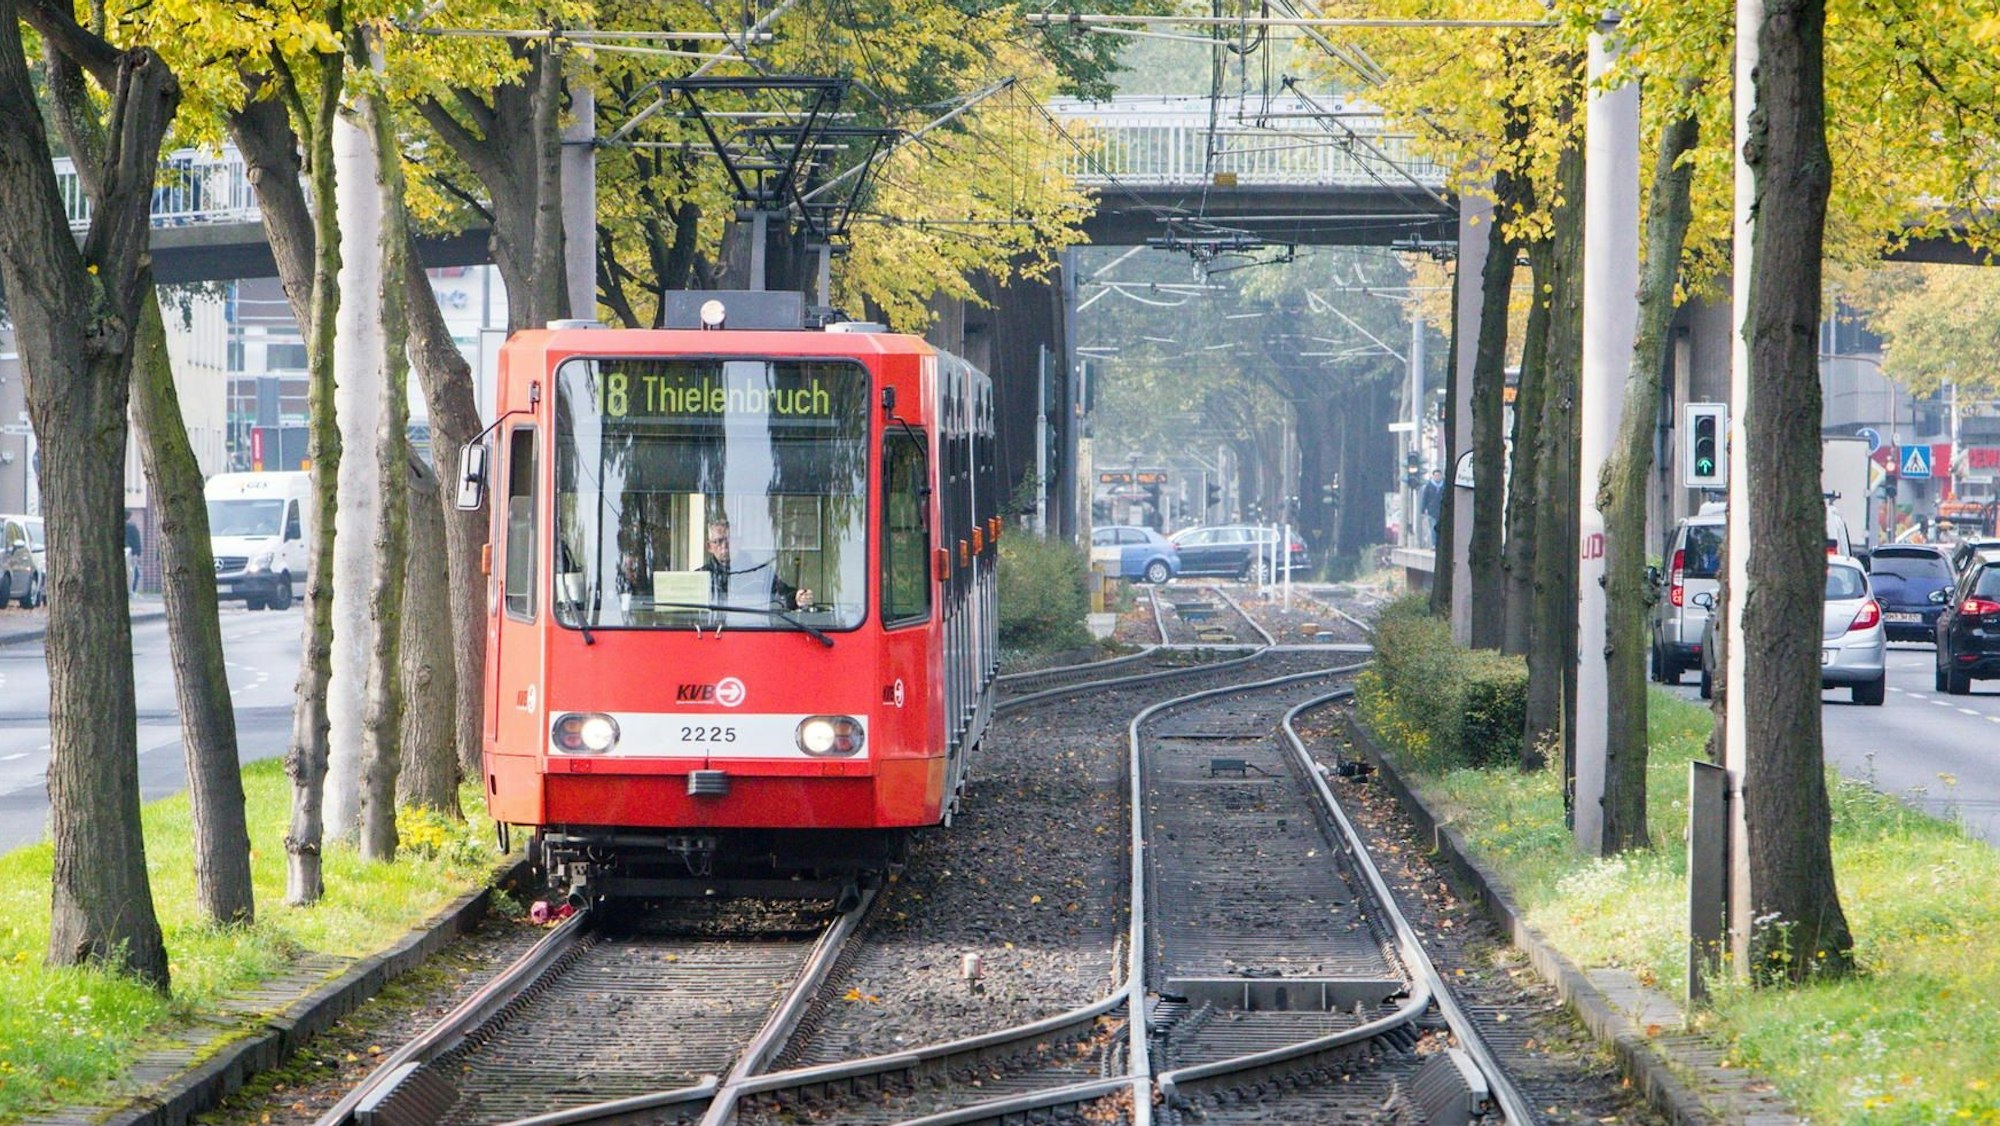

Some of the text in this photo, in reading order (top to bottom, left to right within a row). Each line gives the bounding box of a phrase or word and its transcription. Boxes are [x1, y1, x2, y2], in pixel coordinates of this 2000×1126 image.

[642, 376, 830, 415] Thielenbruch
[676, 684, 715, 701] KVB
[681, 726, 737, 743] 2225
